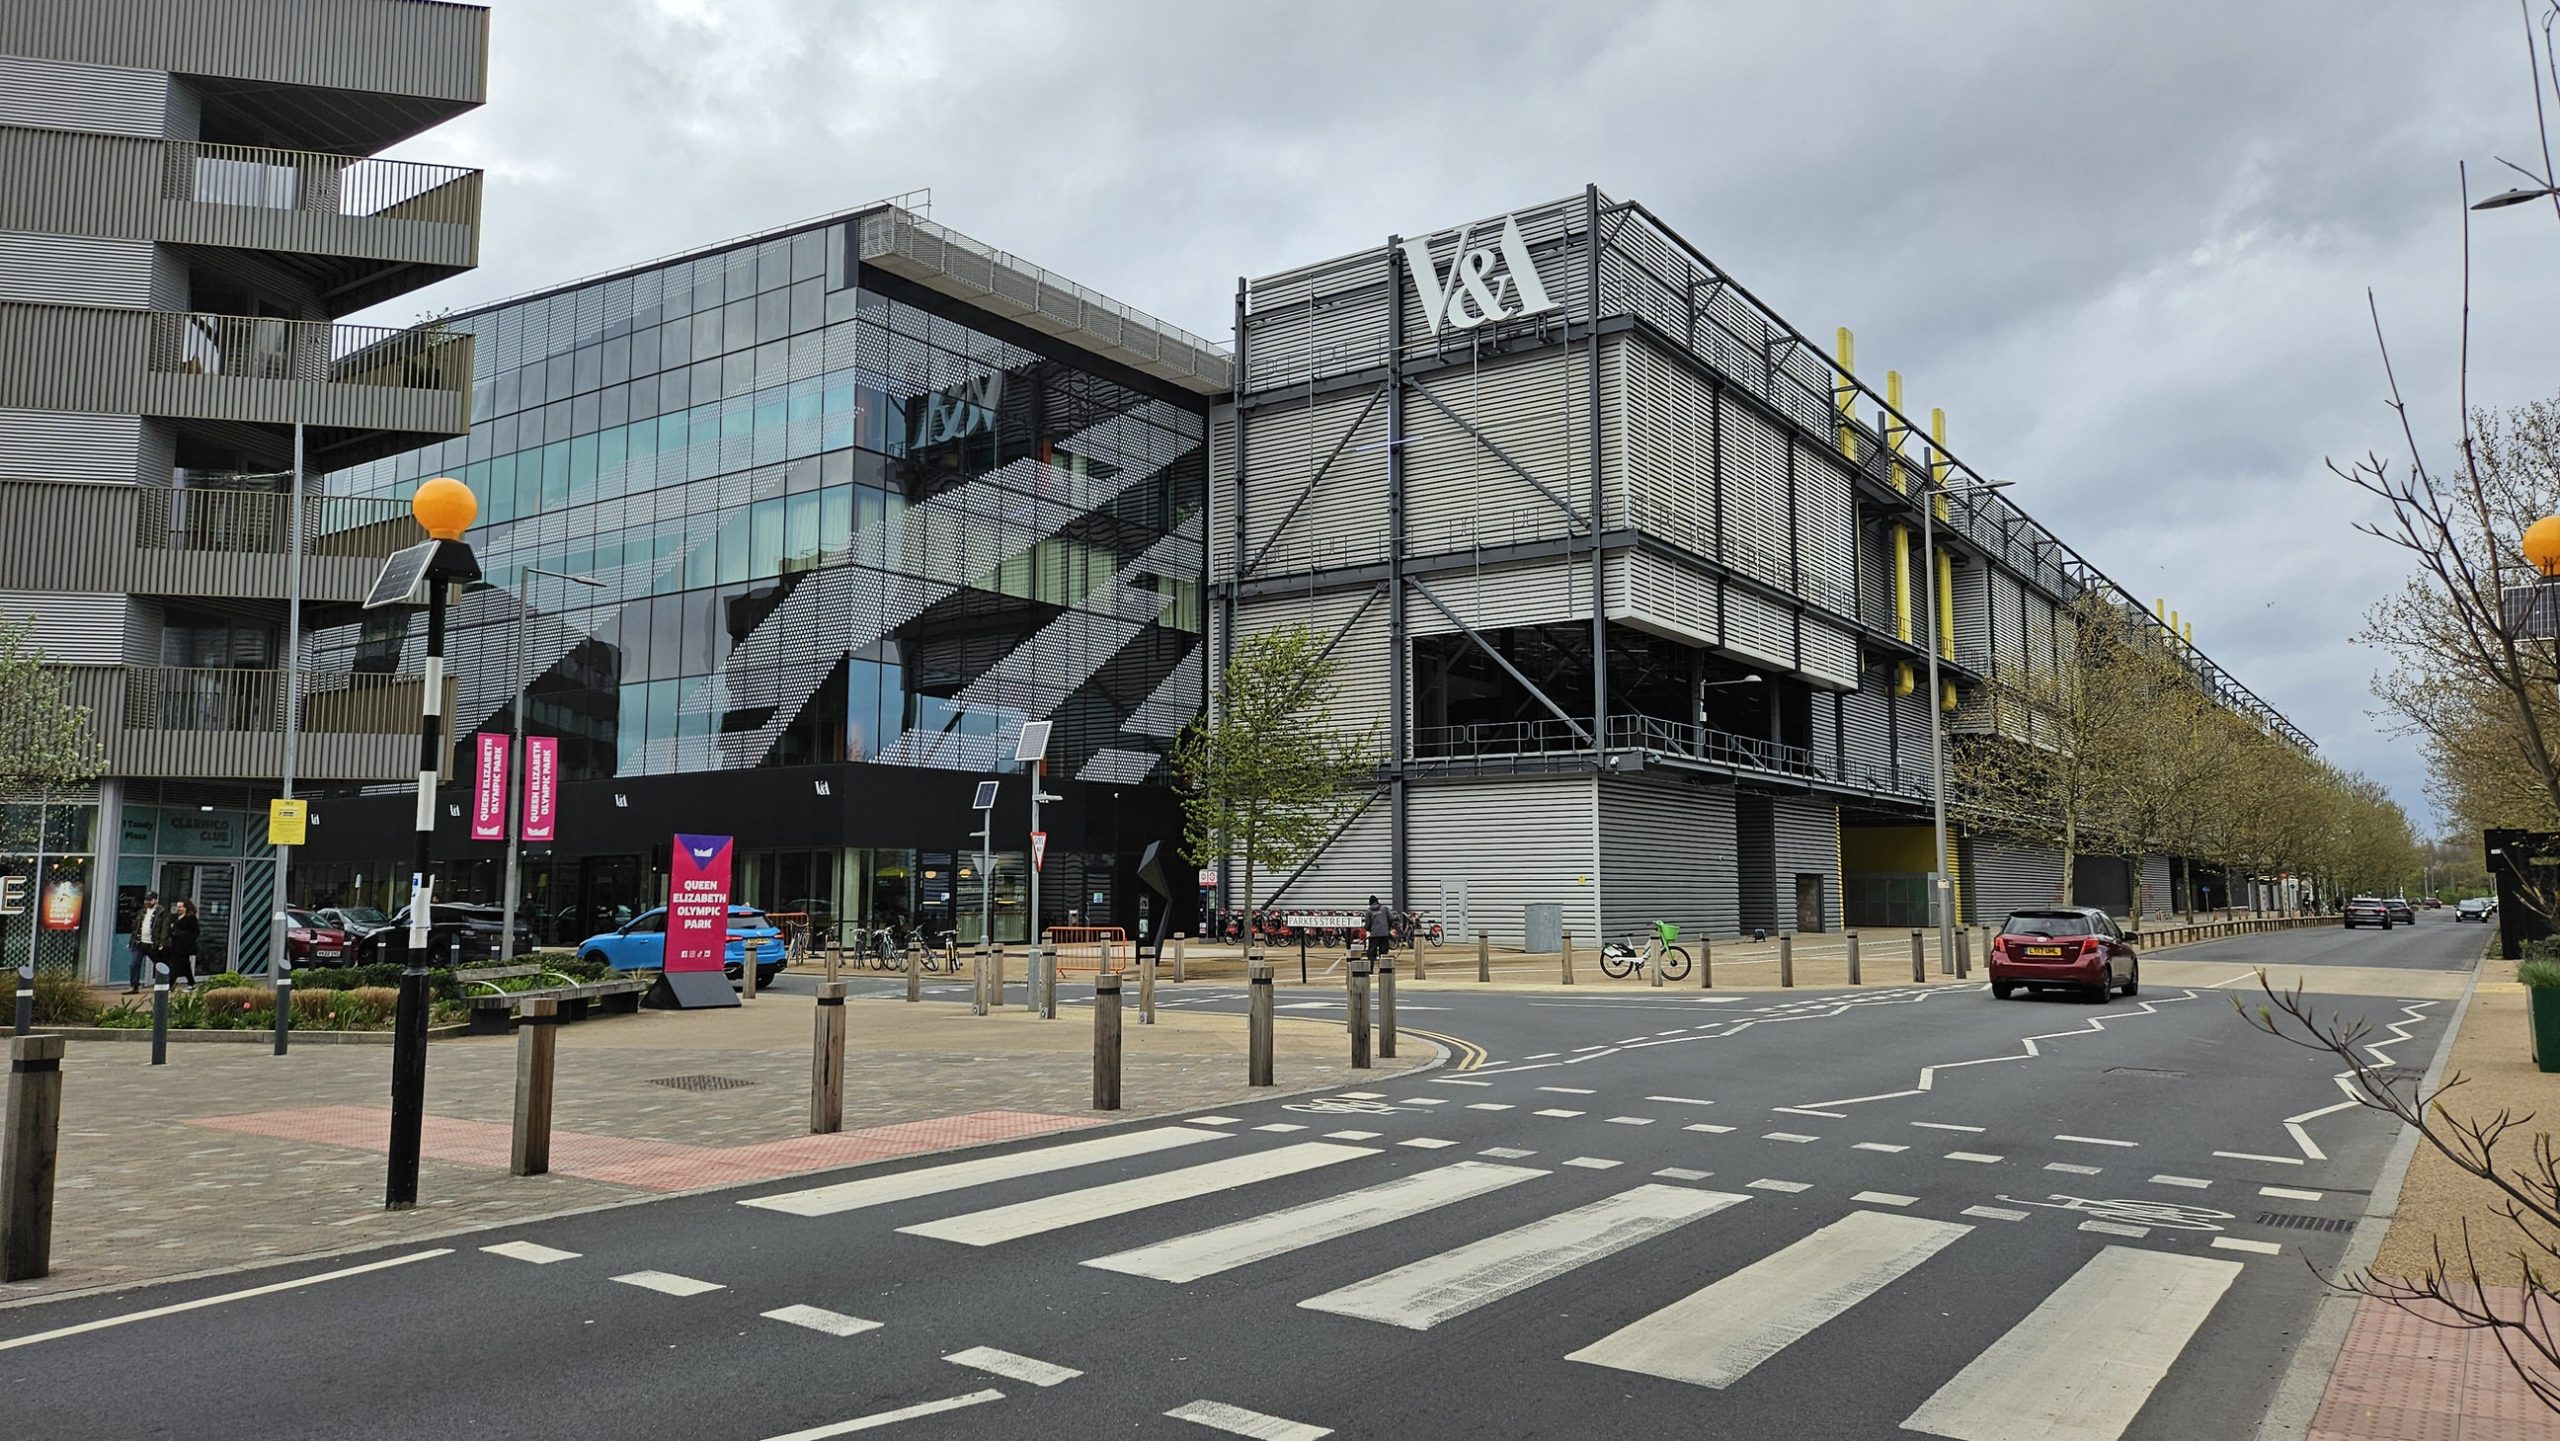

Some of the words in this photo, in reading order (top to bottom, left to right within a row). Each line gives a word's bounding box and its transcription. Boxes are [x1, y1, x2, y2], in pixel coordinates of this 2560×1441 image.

[1395, 214, 1562, 337] V&A
[482, 738, 492, 789] ELIZABETH
[494, 746, 503, 772] PARK
[531, 741, 541, 791] ELIZABETH
[542, 749, 551, 773] PARK
[480, 790, 490, 822] QUEEN
[491, 773, 501, 814] OLYMPIC
[541, 774, 551, 815] OLYMPIC
[530, 792, 540, 823] QUEEN
[200, 831, 229, 842] CLUB
[672, 893, 727, 904] ELIZABETH
[684, 880, 718, 891] QUEEN
[677, 906, 721, 916] OLYMPIC
[684, 919, 712, 929] PARK
[1288, 917, 1319, 926] PARKES
[1320, 917, 1353, 926] STREET
